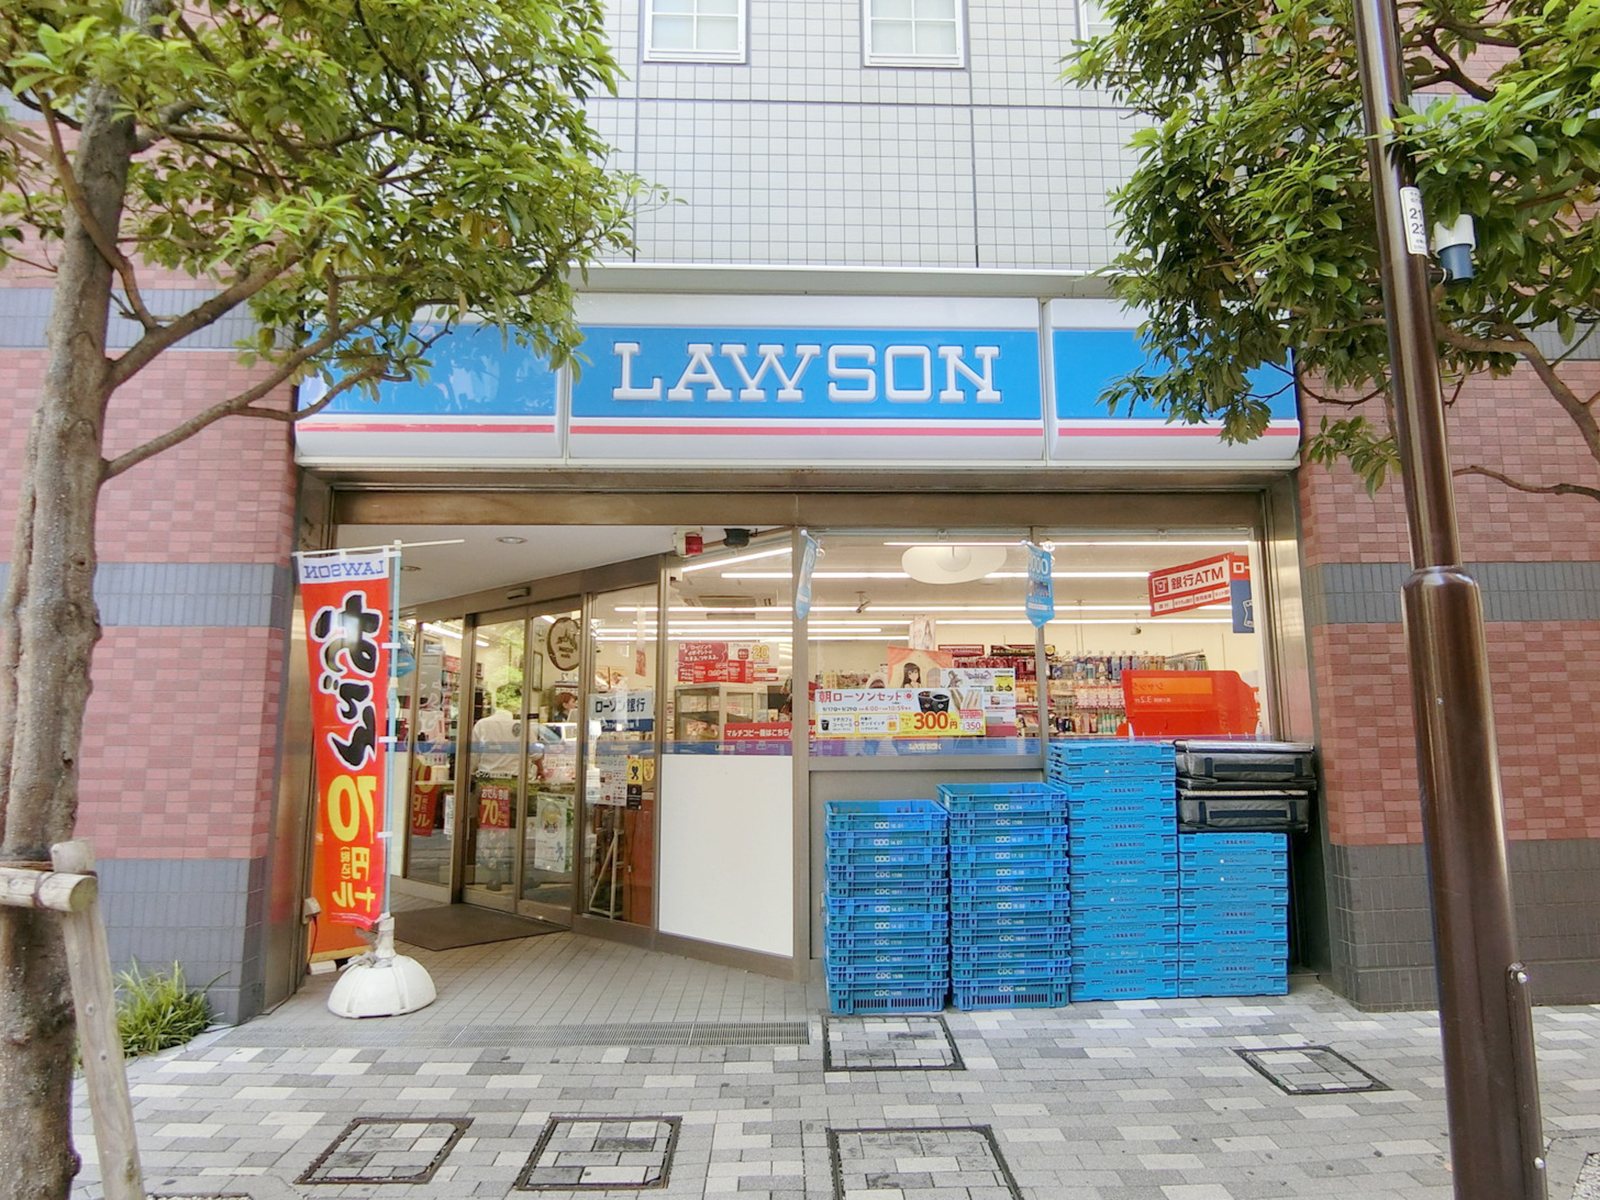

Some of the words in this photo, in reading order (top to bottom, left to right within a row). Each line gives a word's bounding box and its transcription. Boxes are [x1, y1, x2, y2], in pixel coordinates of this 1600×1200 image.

[612, 341, 1003, 403] LAWSON
[1171, 566, 1224, 590] 銀行ATM
[819, 691, 901, 703] 朝ローソンセット
